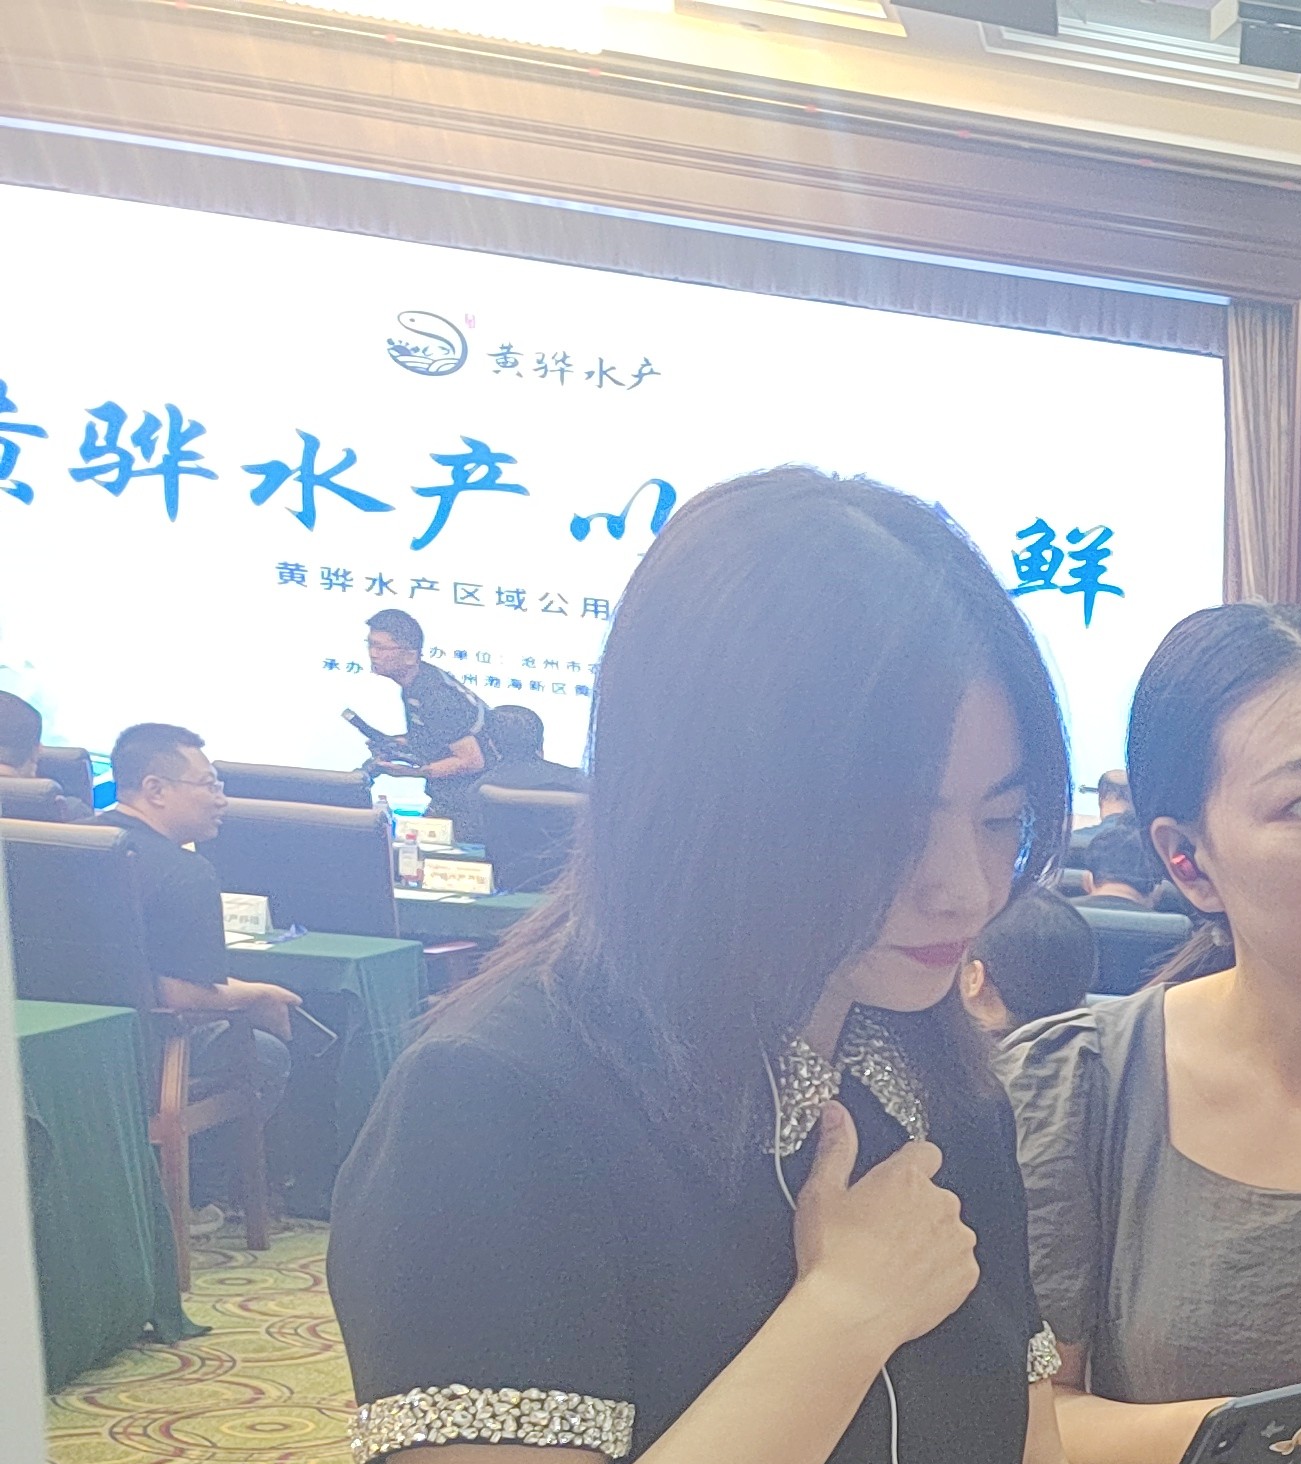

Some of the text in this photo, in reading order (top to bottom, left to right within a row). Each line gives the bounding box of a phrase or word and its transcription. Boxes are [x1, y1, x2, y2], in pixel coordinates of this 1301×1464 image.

[487, 342, 661, 390] 黄骅水产
[275, 559, 611, 621] 黄骅水产区域公用
[1007, 516, 1126, 626] 鲜
